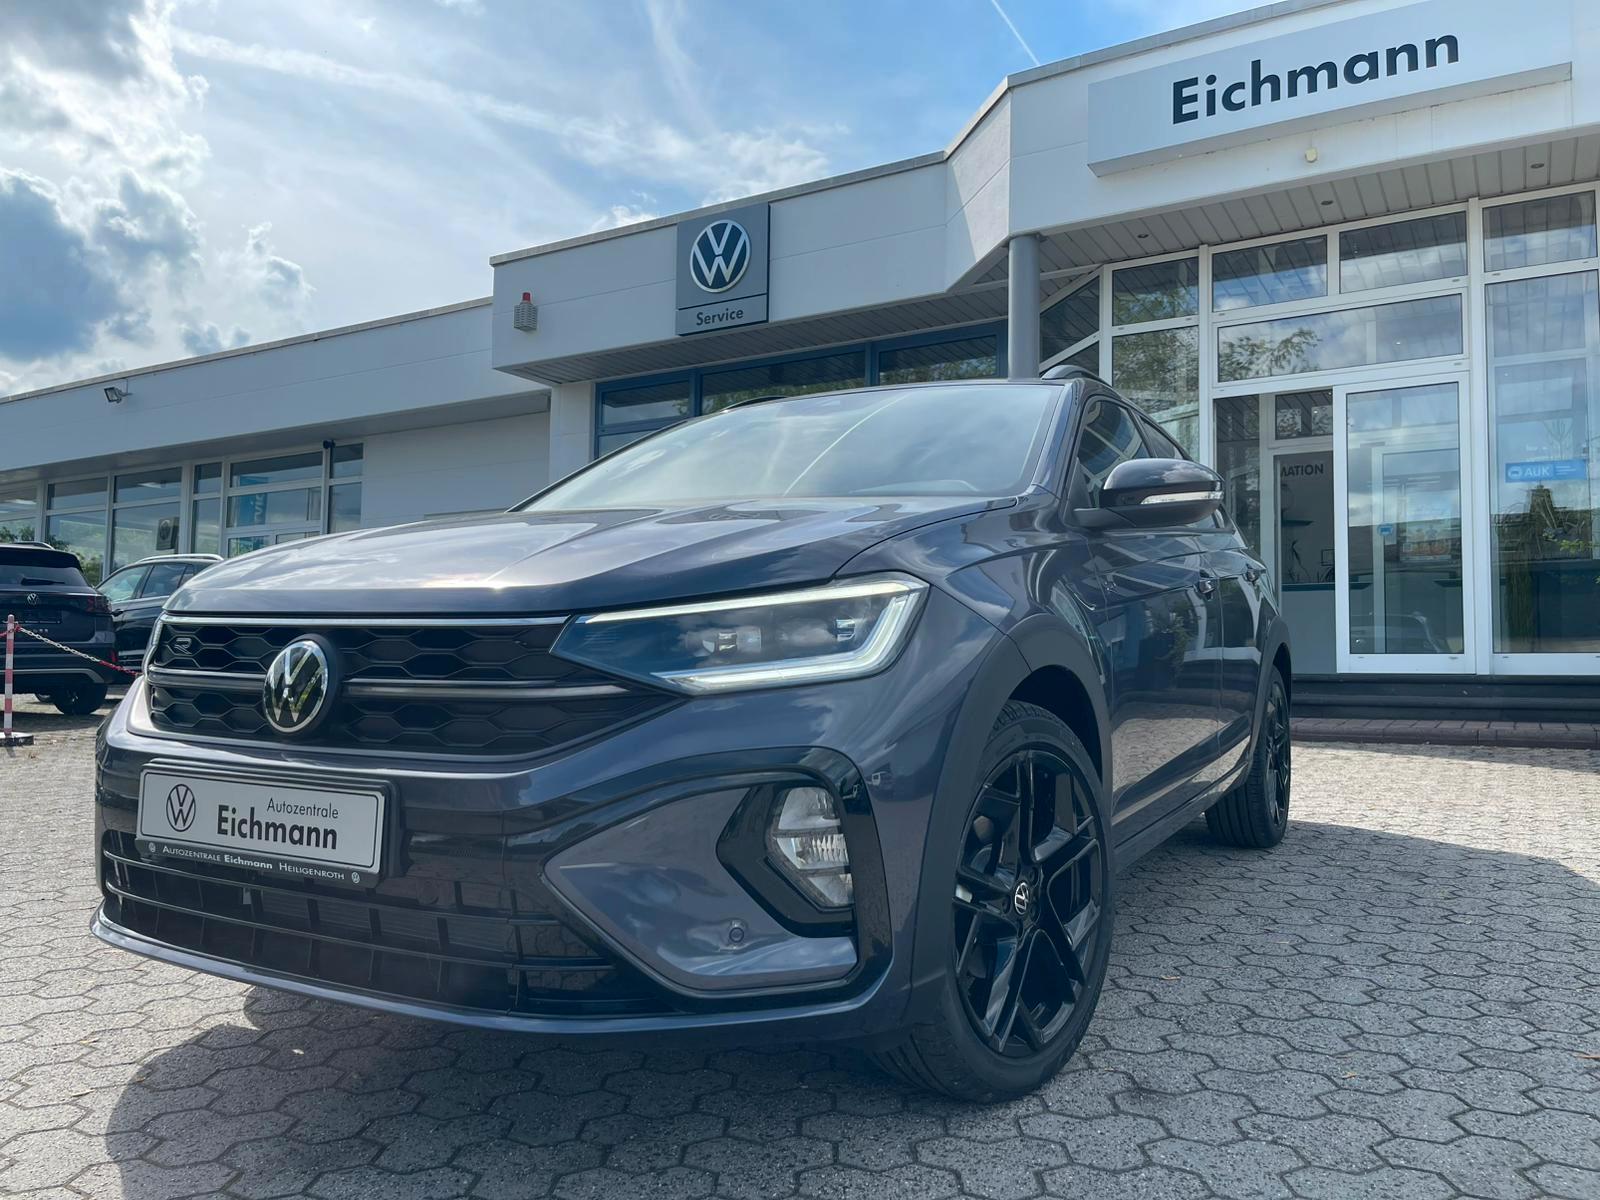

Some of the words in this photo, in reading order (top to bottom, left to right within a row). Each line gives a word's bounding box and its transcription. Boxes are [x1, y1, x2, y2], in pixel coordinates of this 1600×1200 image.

[1173, 33, 1460, 125] Eichmann
[696, 308, 744, 326] Service
[267, 797, 339, 819] Autozentrale
[217, 804, 338, 850] Eichmann
[162, 845, 221, 861] AUTOZENTRALE
[224, 854, 273, 869] Eichmann
[279, 862, 345, 880] HEILIGENROTH
